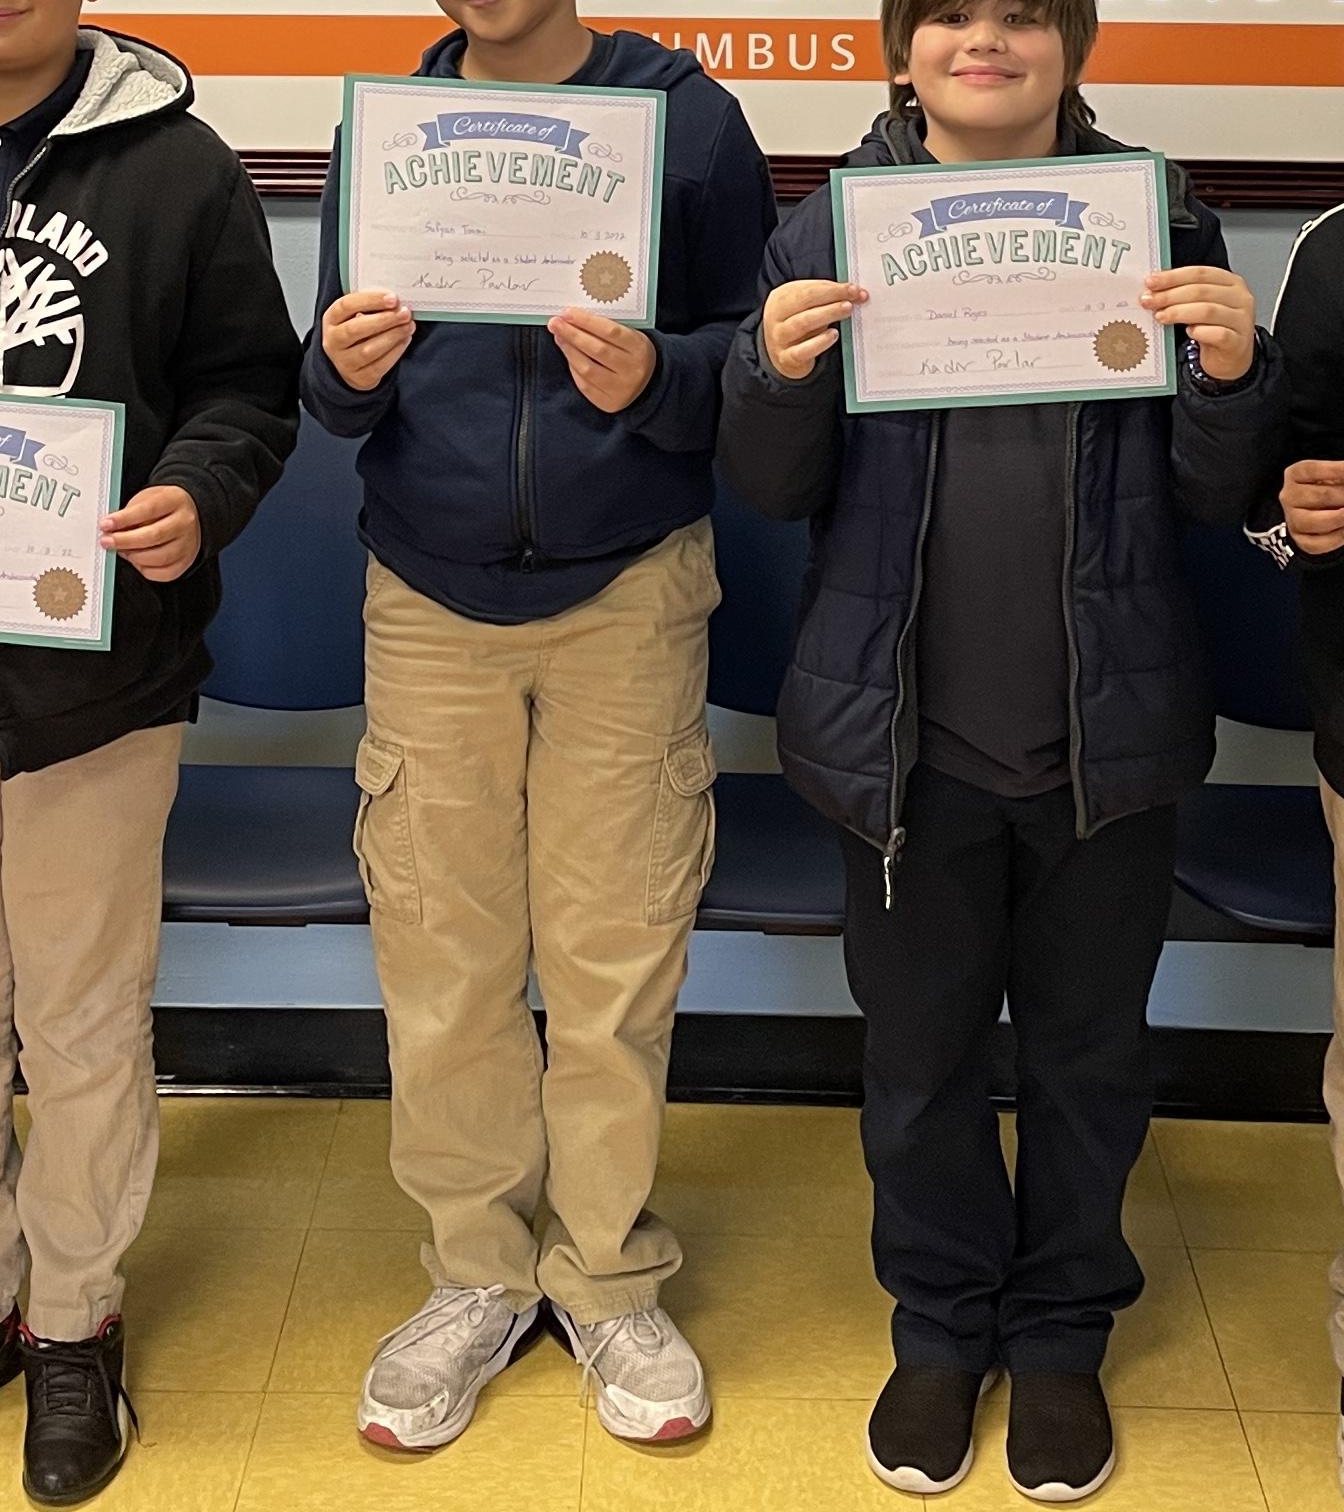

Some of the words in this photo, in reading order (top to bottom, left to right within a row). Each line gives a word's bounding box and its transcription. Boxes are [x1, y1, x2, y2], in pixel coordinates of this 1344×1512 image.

[452, 116, 537, 138] Certificate
[537, 123, 558, 140] of
[383, 150, 626, 204] ACHIEVEMENT
[947, 195, 1034, 220] Certificate
[1035, 198, 1055, 216] of
[881, 229, 1131, 286] ACHIEVEMENT
